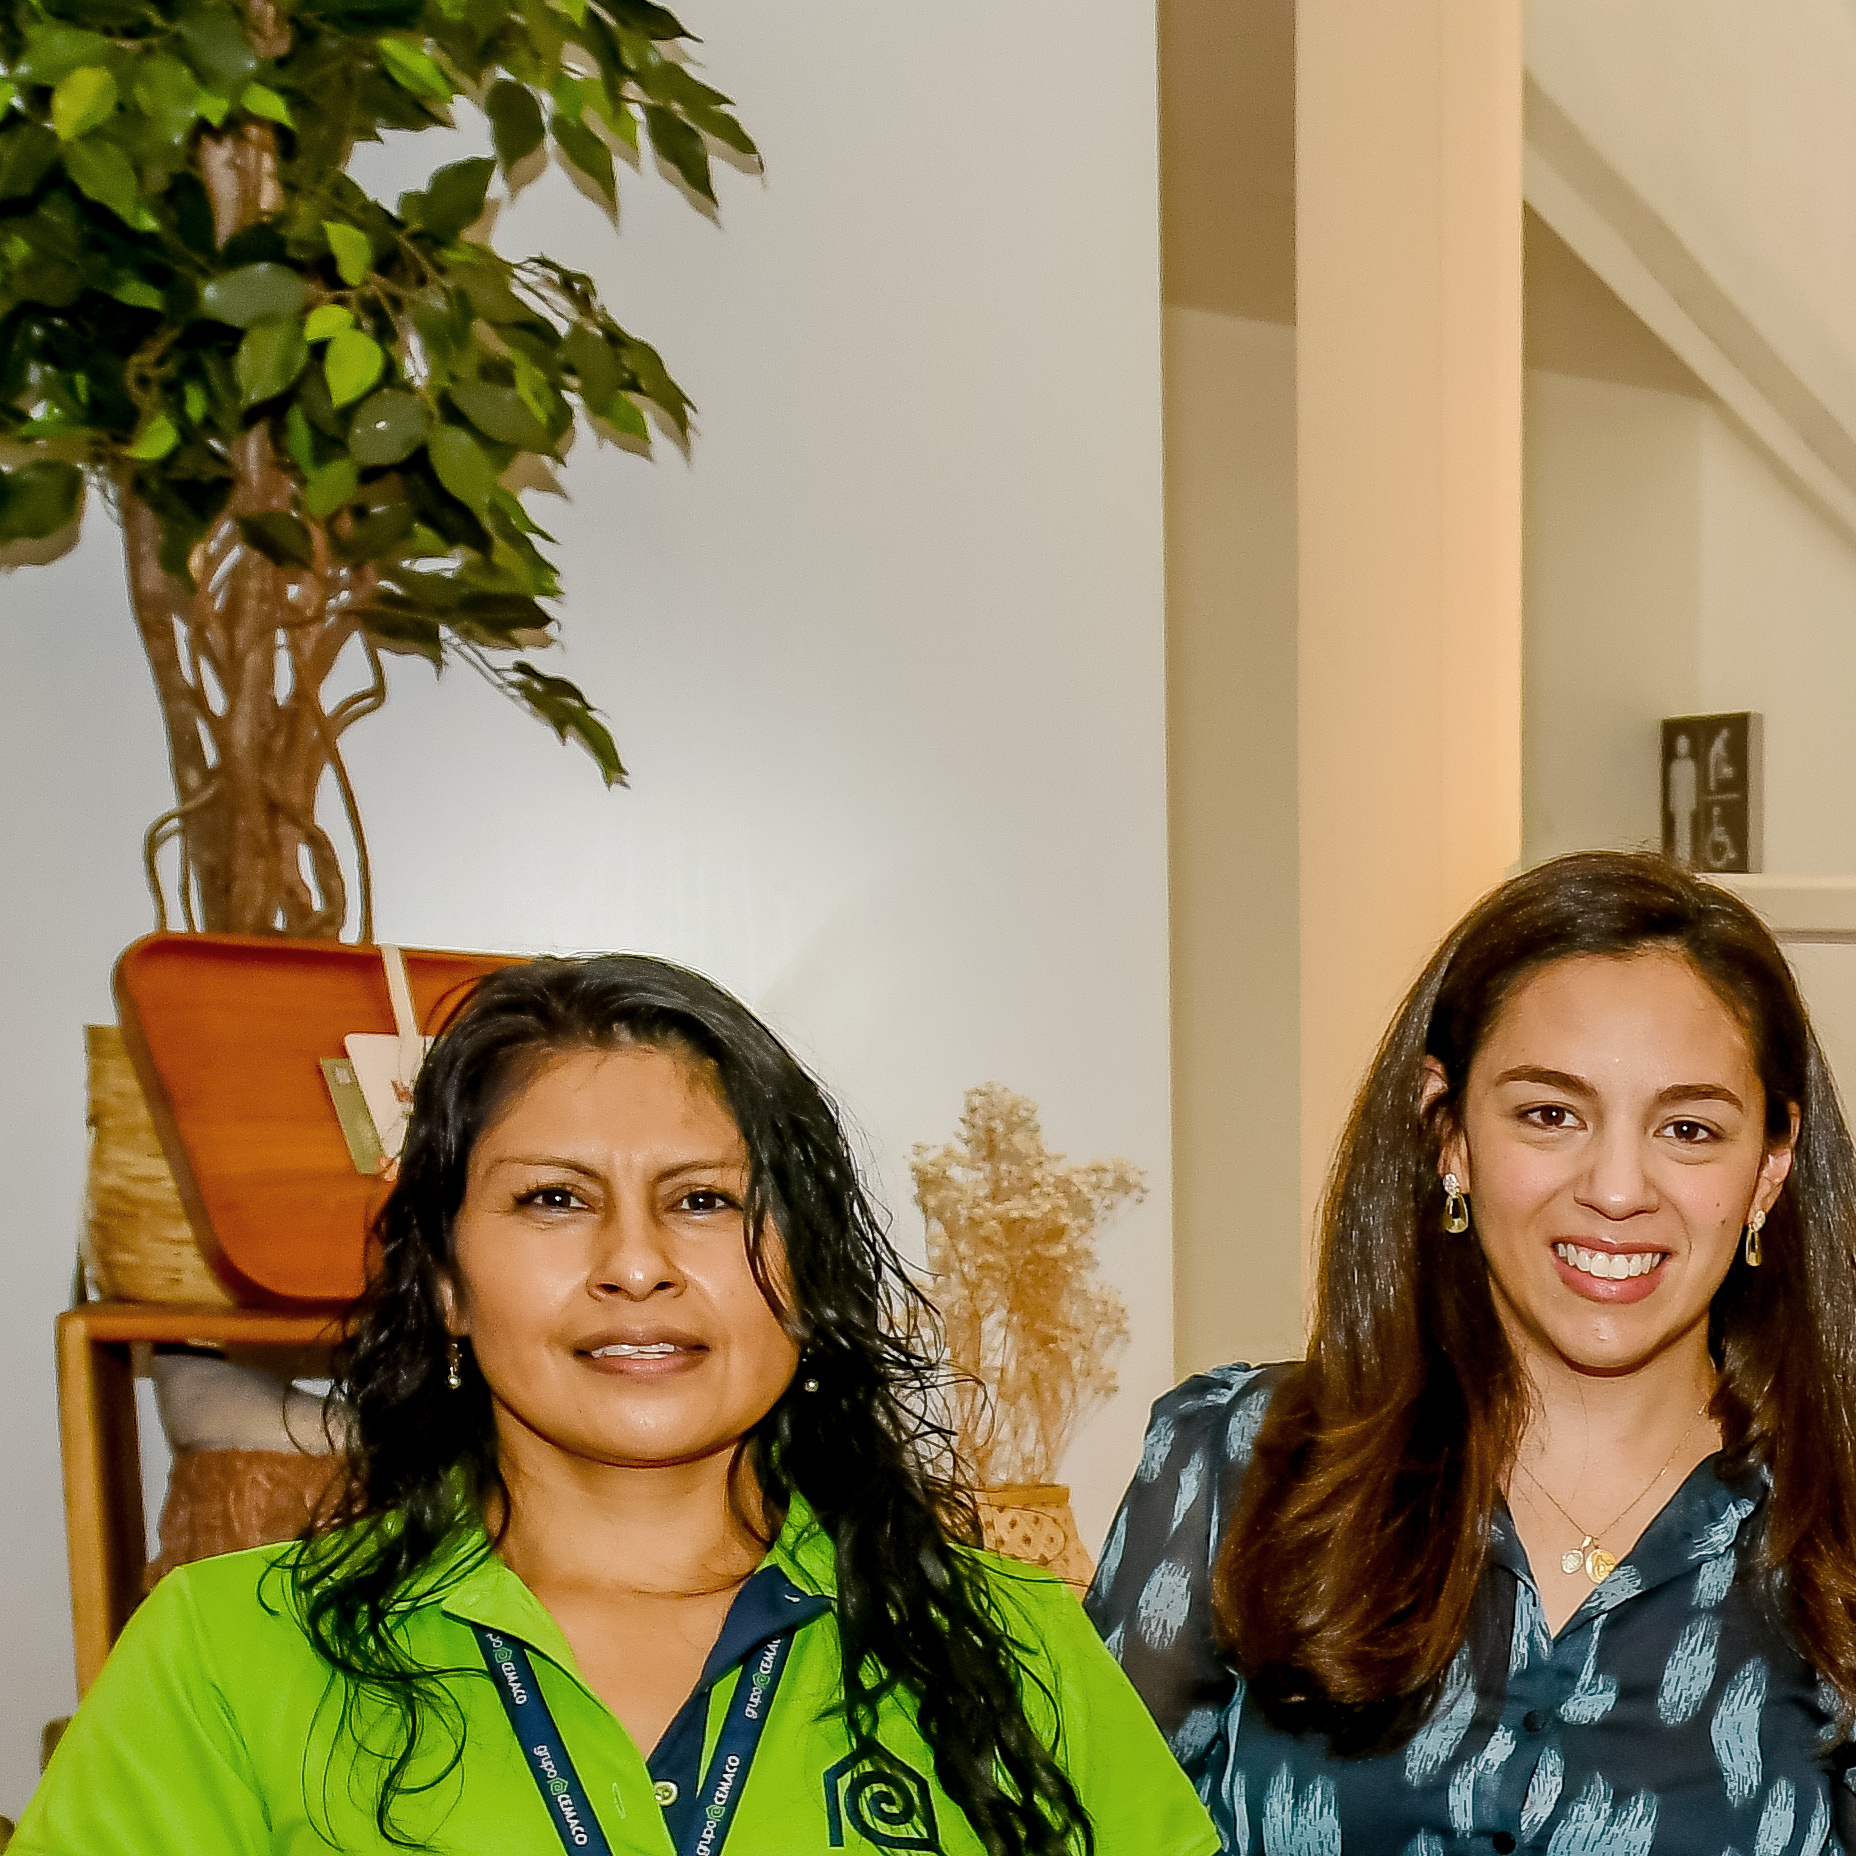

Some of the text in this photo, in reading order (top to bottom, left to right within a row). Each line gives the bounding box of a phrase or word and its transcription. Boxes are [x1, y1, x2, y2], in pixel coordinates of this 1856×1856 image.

[501, 1661, 528, 1705] CEMACO
[745, 1687, 763, 1719] grupo
[533, 1744, 588, 1846] grupo CEMACO
[696, 1755, 741, 1856] grupo CEMACO
